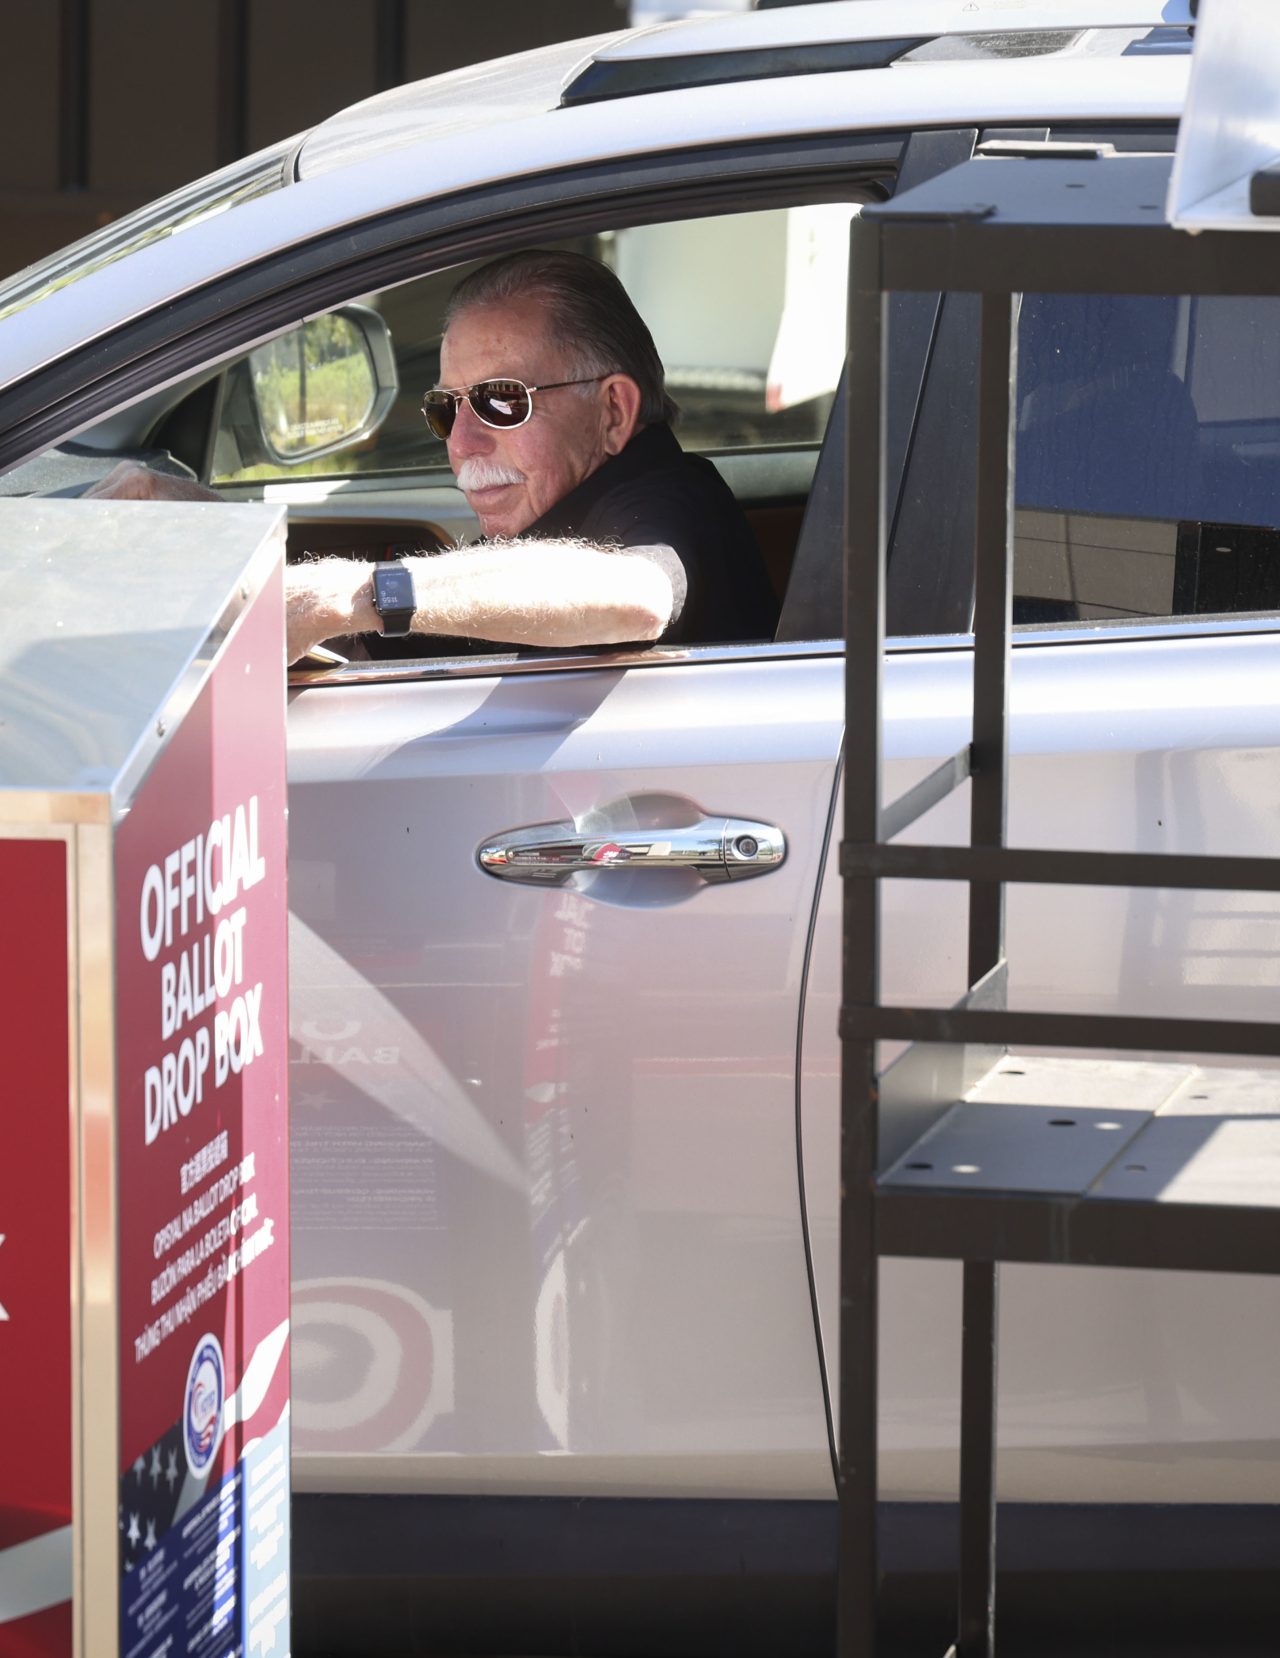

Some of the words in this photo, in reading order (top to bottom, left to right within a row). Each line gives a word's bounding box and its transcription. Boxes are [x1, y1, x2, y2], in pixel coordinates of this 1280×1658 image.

[140, 796, 265, 961] OFFICIAL
[162, 907, 246, 1041] BALLOT
[145, 1026, 210, 1146] DROP
[215, 982, 263, 1088] BOX
